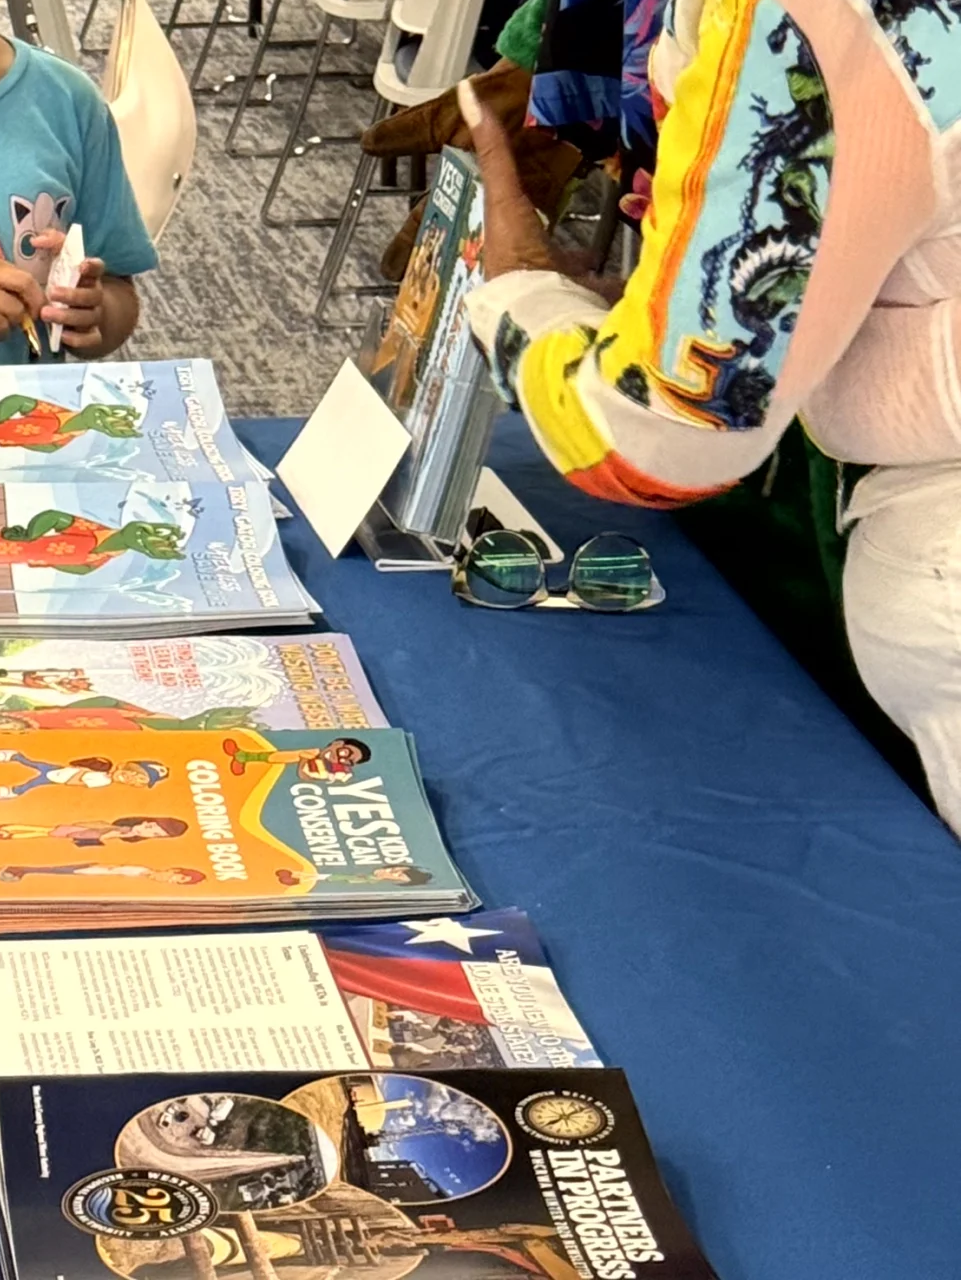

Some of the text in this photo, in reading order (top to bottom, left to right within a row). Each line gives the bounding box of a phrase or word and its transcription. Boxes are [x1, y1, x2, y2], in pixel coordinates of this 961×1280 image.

[174, 366, 197, 391] IRRY
[227, 486, 247, 512] IRRY
[234, 515, 257, 550] GATOR
[241, 551, 269, 588] COLORING
[152, 646, 178, 687] LEAKS AND
[309, 643, 344, 673] DON'T
[277, 644, 335, 730] WASTING WEASE
[324, 677, 352, 691] BE
[337, 704, 370, 729] WATE
[186, 760, 248, 881] COLORING BOOK
[290, 783, 347, 867] CONSERVE!
[327, 776, 413, 864] YES KIDS
[345, 837, 382, 865] CAN
[495, 949, 524, 976] ARE
[506, 977, 536, 1003] YOU
[469, 964, 538, 1063] LONE STAR STATE?
[534, 1031, 562, 1047] TO
[528, 1149, 554, 1189] WHCRWA
[112, 1188, 175, 1224] 25
[147, 1172, 211, 1237] WEST HARRIS COUNTY
[540, 1190, 566, 1220] WINTER
[547, 1149, 636, 1279] IN PROGRESS
[584, 1149, 665, 1263] PARTNERS
[561, 1240, 594, 1279] NEWSLETTER
